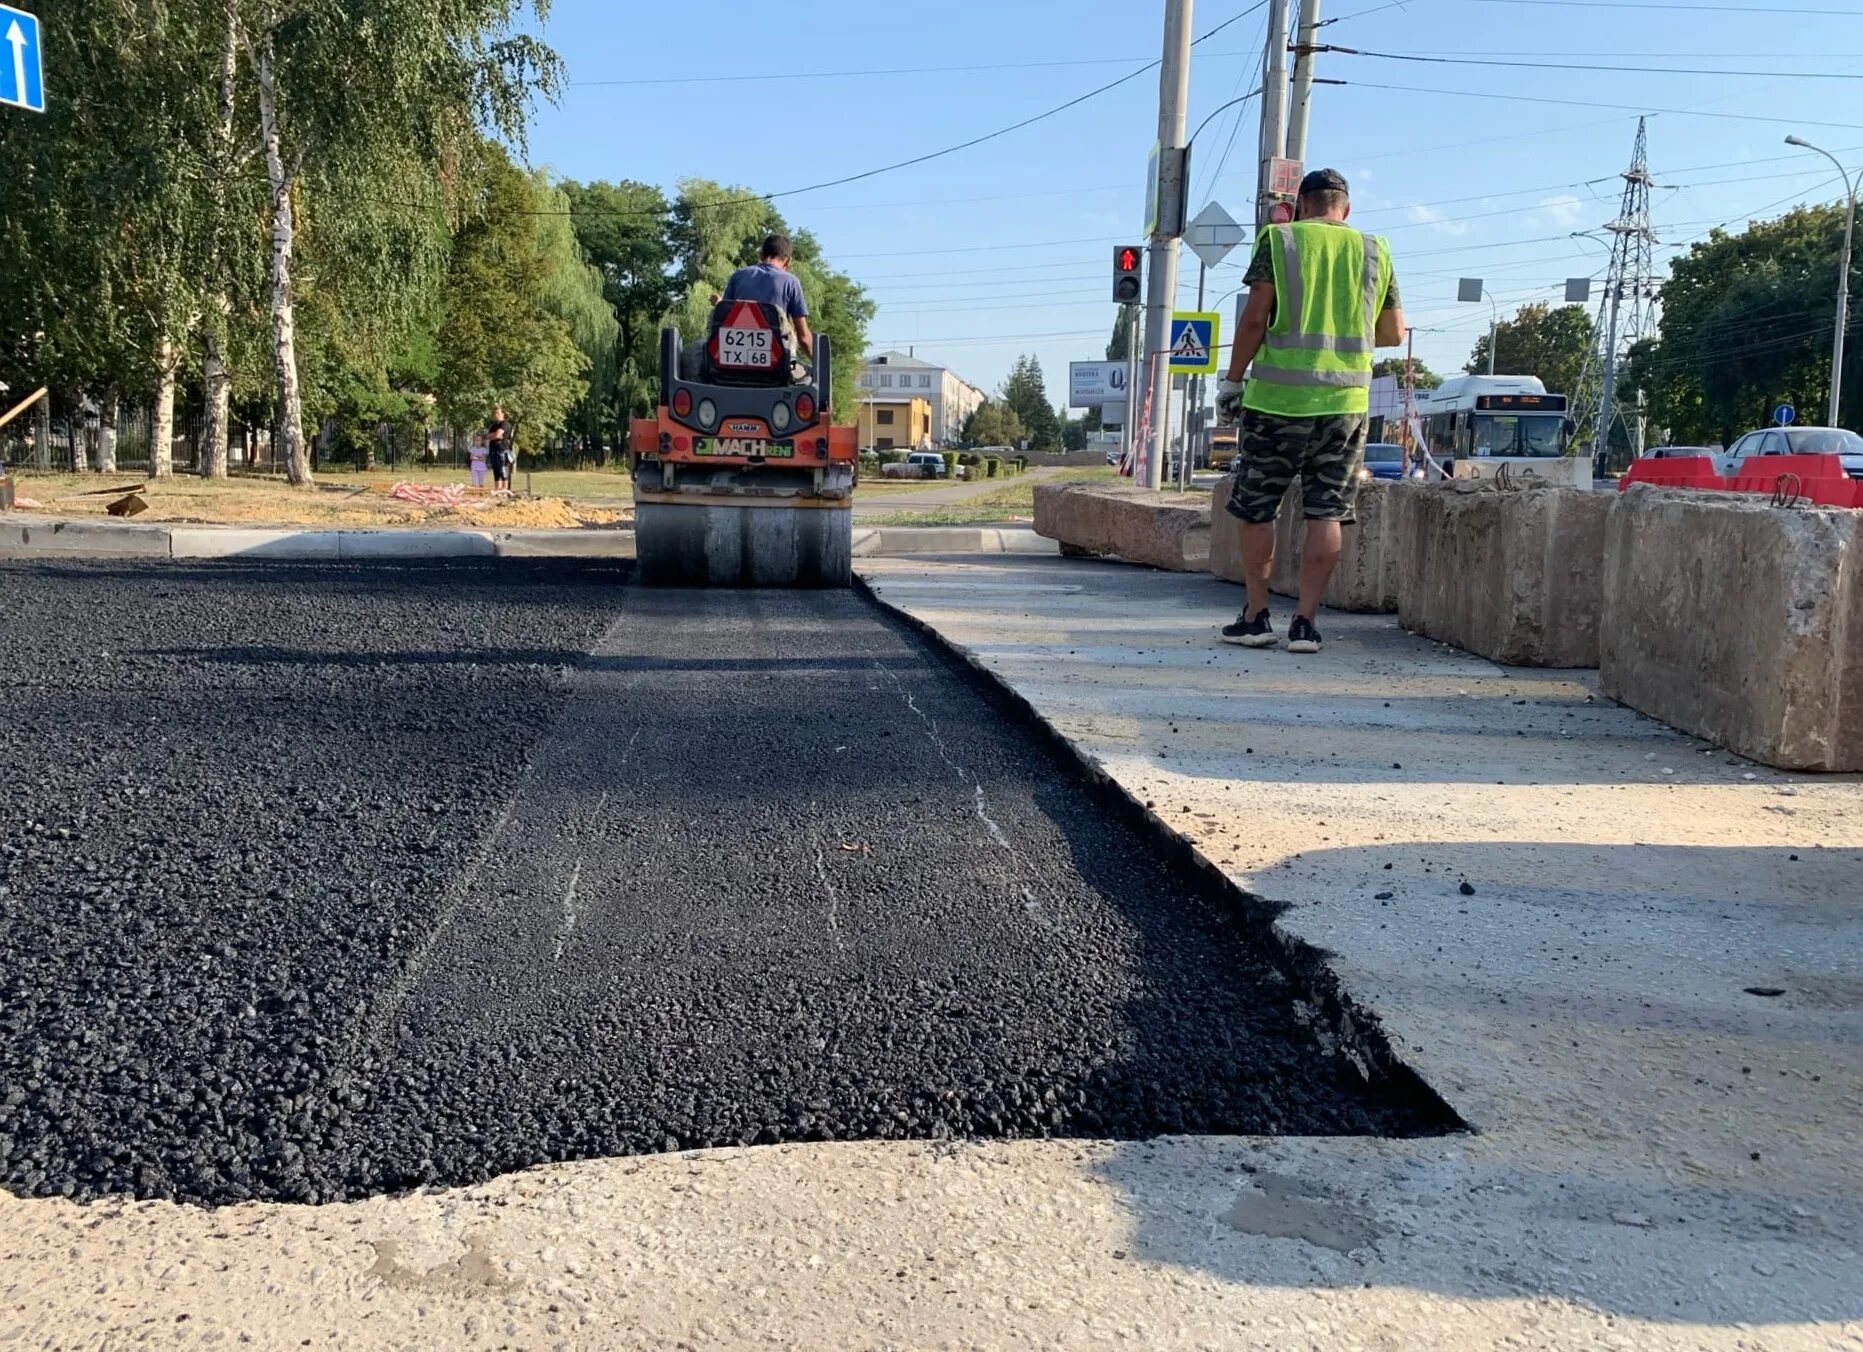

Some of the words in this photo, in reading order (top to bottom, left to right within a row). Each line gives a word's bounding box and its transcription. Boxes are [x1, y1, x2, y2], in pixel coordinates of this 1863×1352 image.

[725, 331, 766, 348] 6215
[751, 352, 767, 364] 68
[732, 424, 758, 432] HAMM
